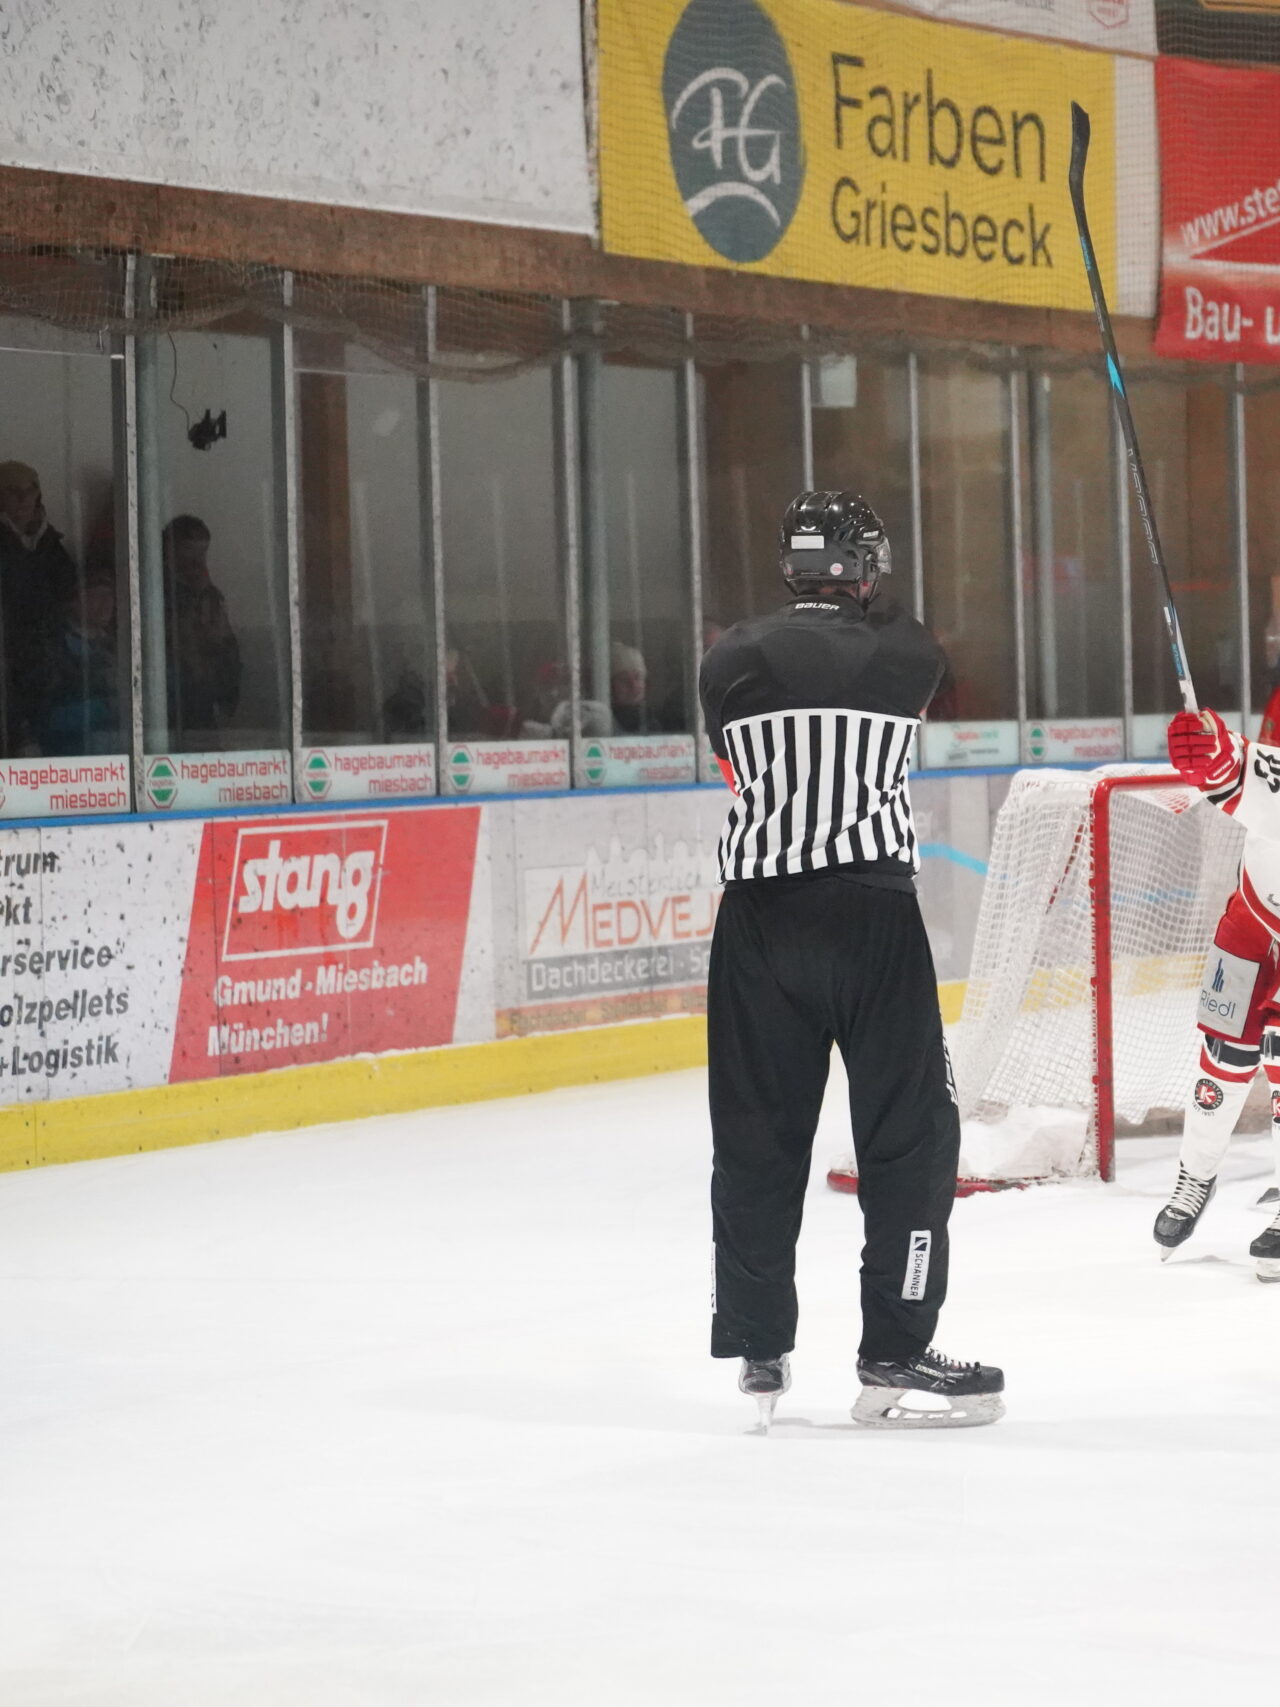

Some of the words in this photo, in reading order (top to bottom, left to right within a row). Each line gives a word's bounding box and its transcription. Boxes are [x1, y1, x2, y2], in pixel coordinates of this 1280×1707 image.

[830, 52, 1047, 183] Farben
[830, 176, 1053, 268] Griesbeck
[1184, 287, 1254, 343] Bau-
[181, 759, 288, 784] hagebaumarkt
[334, 751, 432, 776] hagebaumarkt
[476, 746, 566, 770] hagebaumarkt
[8, 764, 127, 790] hagebaumarkt
[368, 775, 432, 794] miesbach
[507, 769, 567, 789] miesbach
[50, 790, 127, 810] miesbach
[218, 784, 289, 803] miesbach
[0, 851, 57, 878] rum
[238, 839, 375, 939] stang
[528, 871, 724, 956] MEDVEJ
[214, 968, 302, 1007] Gmund
[315, 956, 428, 995] Miesbach
[531, 948, 674, 992] Dachdeckerei
[1201, 989, 1237, 1020] Riedl
[207, 1012, 329, 1057] München!
[909, 1253, 924, 1297] SCHANNER
